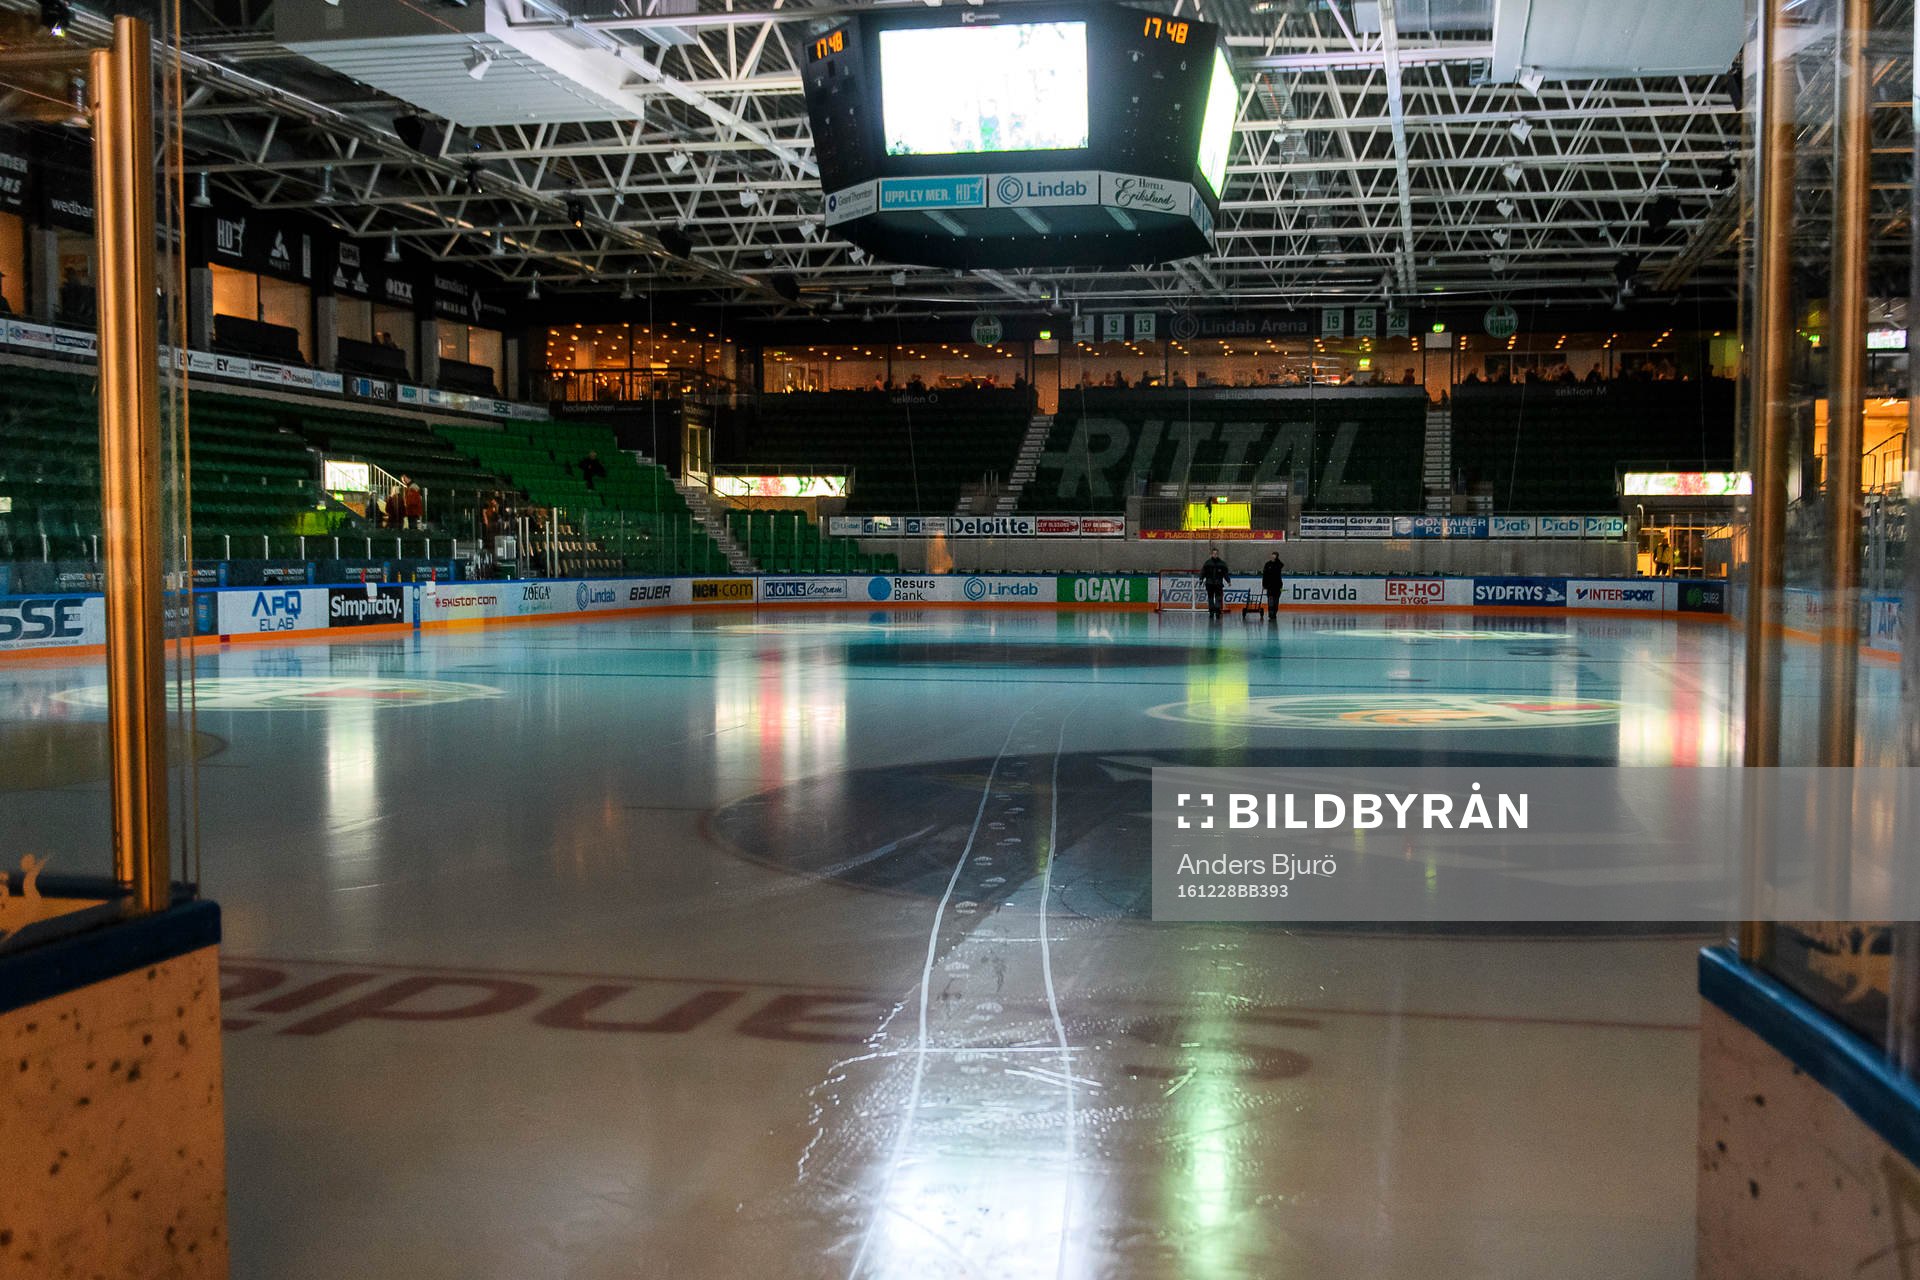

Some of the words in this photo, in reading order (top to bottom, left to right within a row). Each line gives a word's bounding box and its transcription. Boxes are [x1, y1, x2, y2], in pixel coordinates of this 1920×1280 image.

[1026, 180, 1087, 197] Lindab
[1138, 177, 1164, 190] HOTELL
[885, 190, 922, 203] UPPLEV
[924, 189, 951, 201] MER.
[1110, 320, 1118, 333] 9
[1139, 319, 1151, 333] 13
[1202, 319, 1255, 333] Lindab
[1260, 320, 1308, 333] Arena
[1327, 315, 1340, 329] 19
[1358, 315, 1373, 329] 25
[1390, 314, 1406, 328] 26
[217, 358, 229, 372] EY
[1555, 387, 1593, 397] sektion
[1596, 386, 1608, 396] M
[493, 401, 511, 415] SSE
[1040, 417, 1374, 503] RITTAL
[950, 517, 1035, 536] Deloitte.
[1415, 517, 1486, 527] CONTAINER
[1425, 527, 1476, 536] POOLEN
[766, 583, 806, 596] KÖKS
[807, 583, 843, 597] Centrum
[894, 578, 936, 588] Resurs
[988, 582, 1039, 596] Lindab
[1388, 582, 1441, 596] ER-HO
[589, 587, 616, 604] Lindab
[629, 585, 672, 601] BAUER
[894, 589, 923, 601] Bank
[1074, 579, 1130, 602] OCAY!
[1293, 583, 1357, 601] bravida
[1475, 585, 1543, 601] SYDFRYS
[1589, 588, 1655, 602] INTERSPORT
[1400, 596, 1428, 605] BYGG
[259, 618, 275, 631] EL
[277, 617, 295, 631] AB
